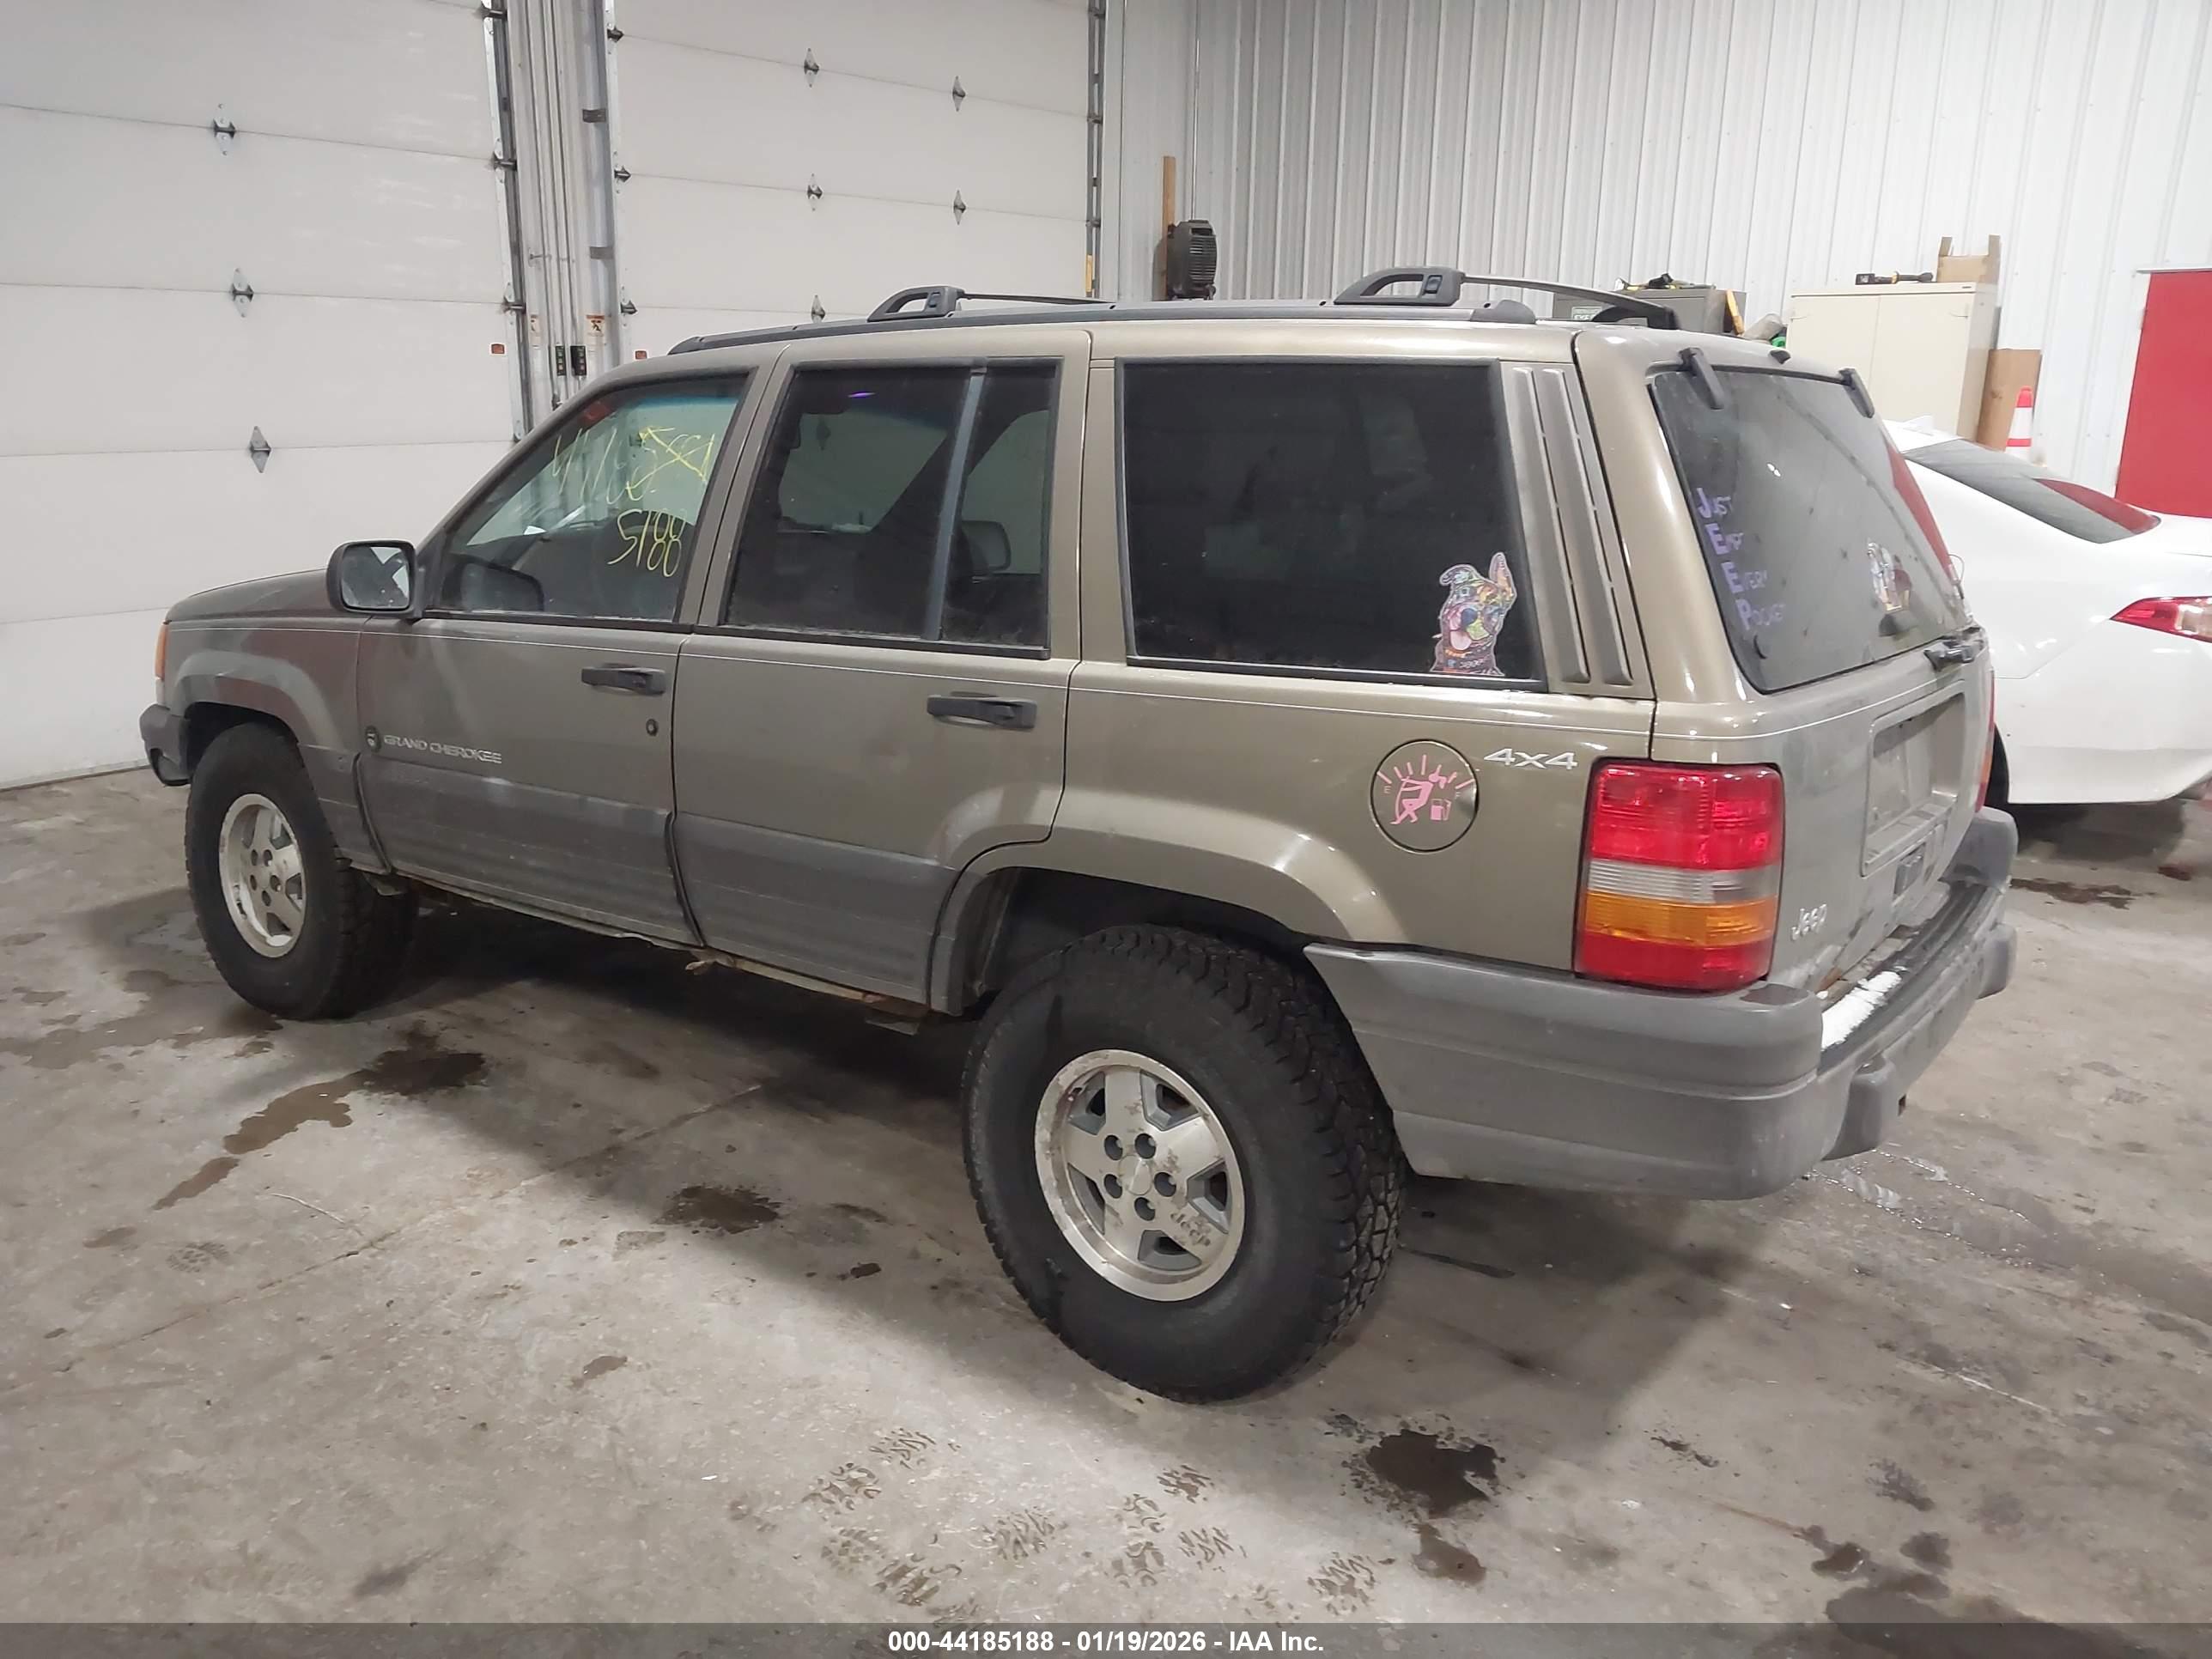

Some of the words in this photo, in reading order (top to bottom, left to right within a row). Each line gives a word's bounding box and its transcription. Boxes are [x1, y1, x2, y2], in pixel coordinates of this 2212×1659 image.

[384, 734, 428, 750] GRAND
[430, 742, 502, 764] CHEROKEE
[1791, 904, 1827, 940] Jeep
